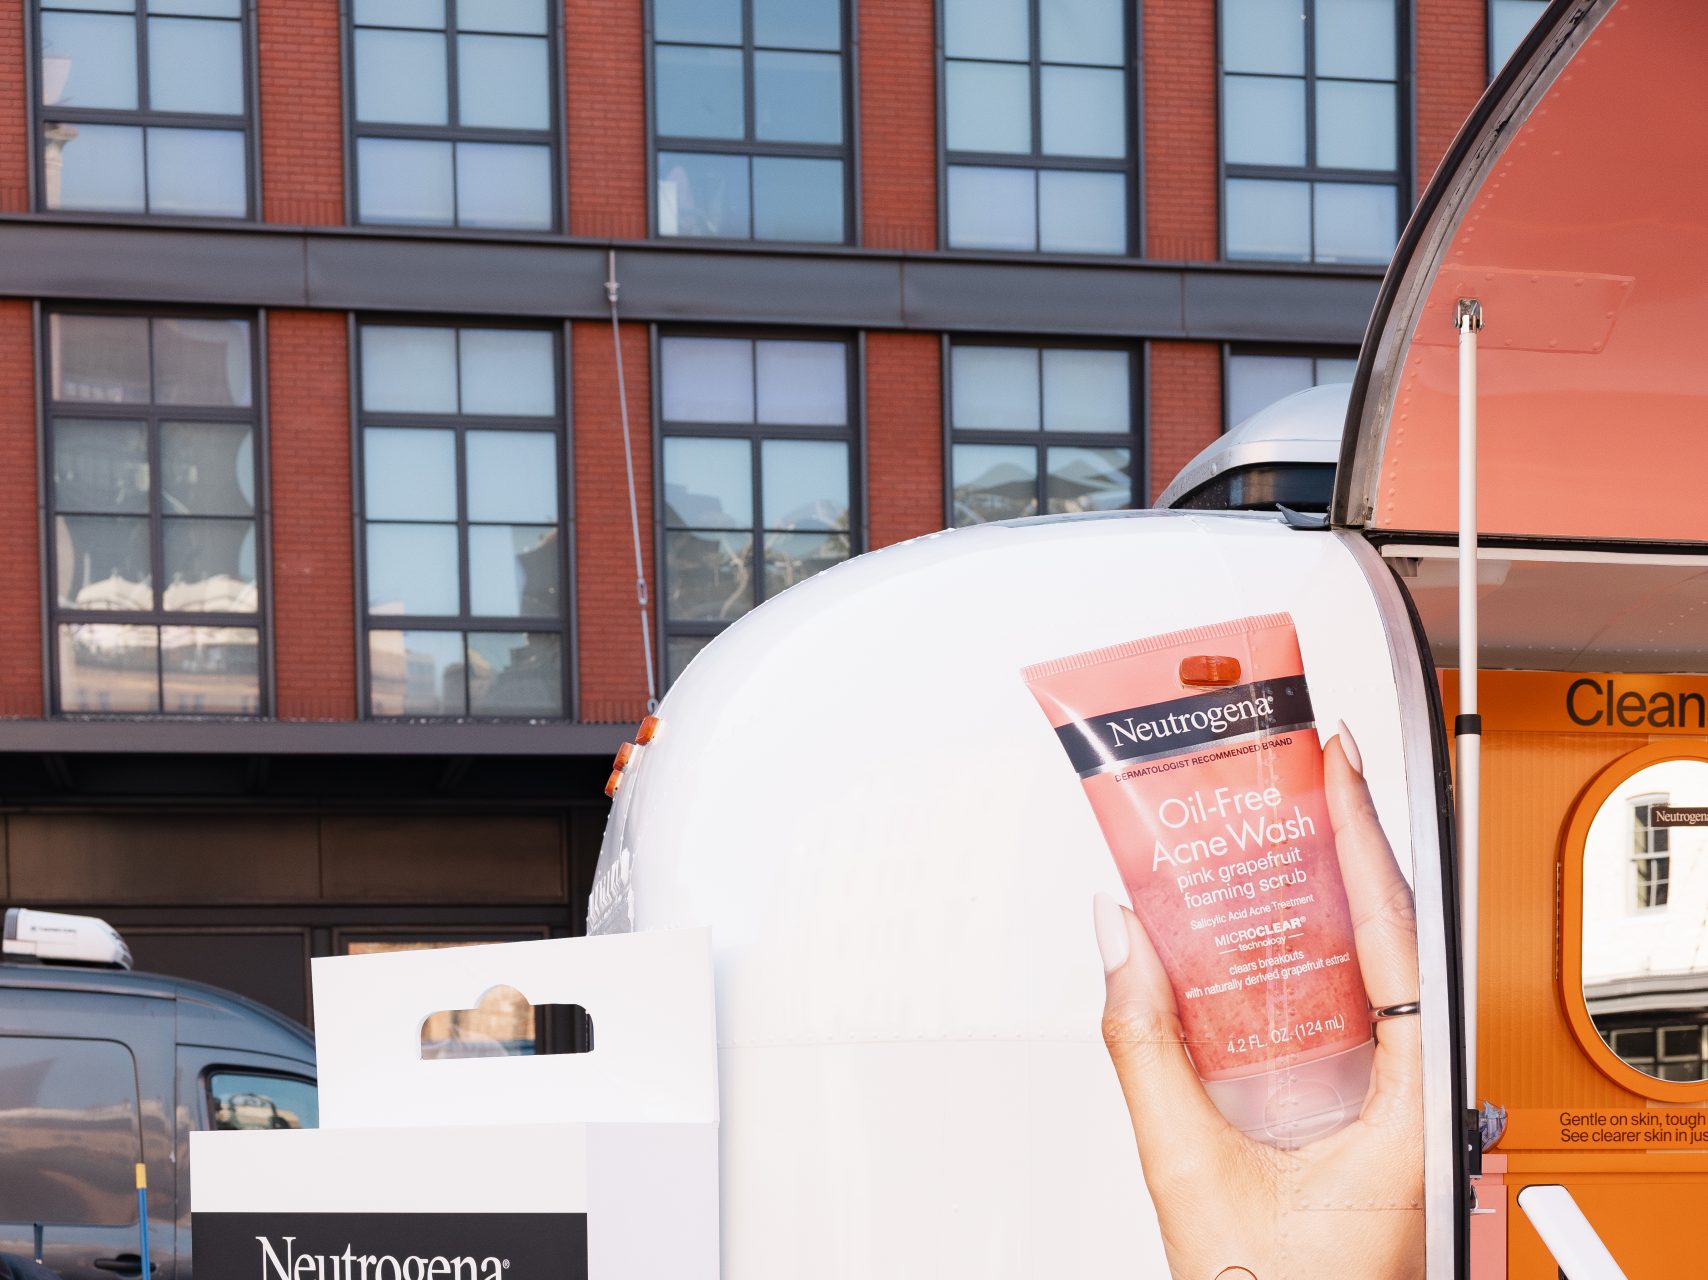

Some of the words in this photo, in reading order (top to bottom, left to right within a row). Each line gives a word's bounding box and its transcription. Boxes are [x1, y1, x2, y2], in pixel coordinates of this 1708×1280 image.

[1566, 678, 1705, 728] Clean
[1115, 760, 1189, 782] DERMATOLOGIST
[1192, 745, 1260, 765] RECOMMENDED
[1262, 738, 1293, 751] BRAND
[1159, 787, 1282, 829] Oil-Free
[1656, 811, 1708, 824] Neutrogen
[1152, 836, 1228, 872] Acne
[1225, 806, 1316, 851] Wash
[1177, 867, 1214, 892] pink
[1219, 847, 1303, 883] grapefruit
[1184, 882, 1255, 909] foaming
[1259, 868, 1307, 892] scrub
[1190, 914, 1226, 931] Salicylic
[1228, 908, 1247, 922] Acid
[1250, 904, 1271, 917] Acne
[1273, 894, 1315, 911] Treatment
[1229, 962, 1257, 976] clears
[1258, 950, 1304, 969] breakouts
[1239, 935, 1287, 953] technology
[1185, 988, 1203, 1000] with
[1204, 979, 1243, 997] naturally
[1245, 972, 1280, 986] derived
[1281, 959, 1324, 979] grapefruit
[1325, 952, 1351, 968] extract
[1227, 1039, 1246, 1054] 4.2
[1248, 1034, 1268, 1051] FL.
[1271, 1028, 1293, 1045] OZ.
[1295, 1020, 1323, 1041] (124
[1324, 1014, 1346, 1032] mL)
[1559, 1112, 1607, 1126] Gentle
[1610, 1115, 1628, 1126] on
[1631, 1112, 1662, 1128] skin,
[1665, 1112, 1706, 1129] tough
[1561, 1128, 1589, 1142] See
[1592, 1128, 1641, 1142] clearer
[1644, 1128, 1672, 1142] skin
[1676, 1128, 1687, 1142] in
